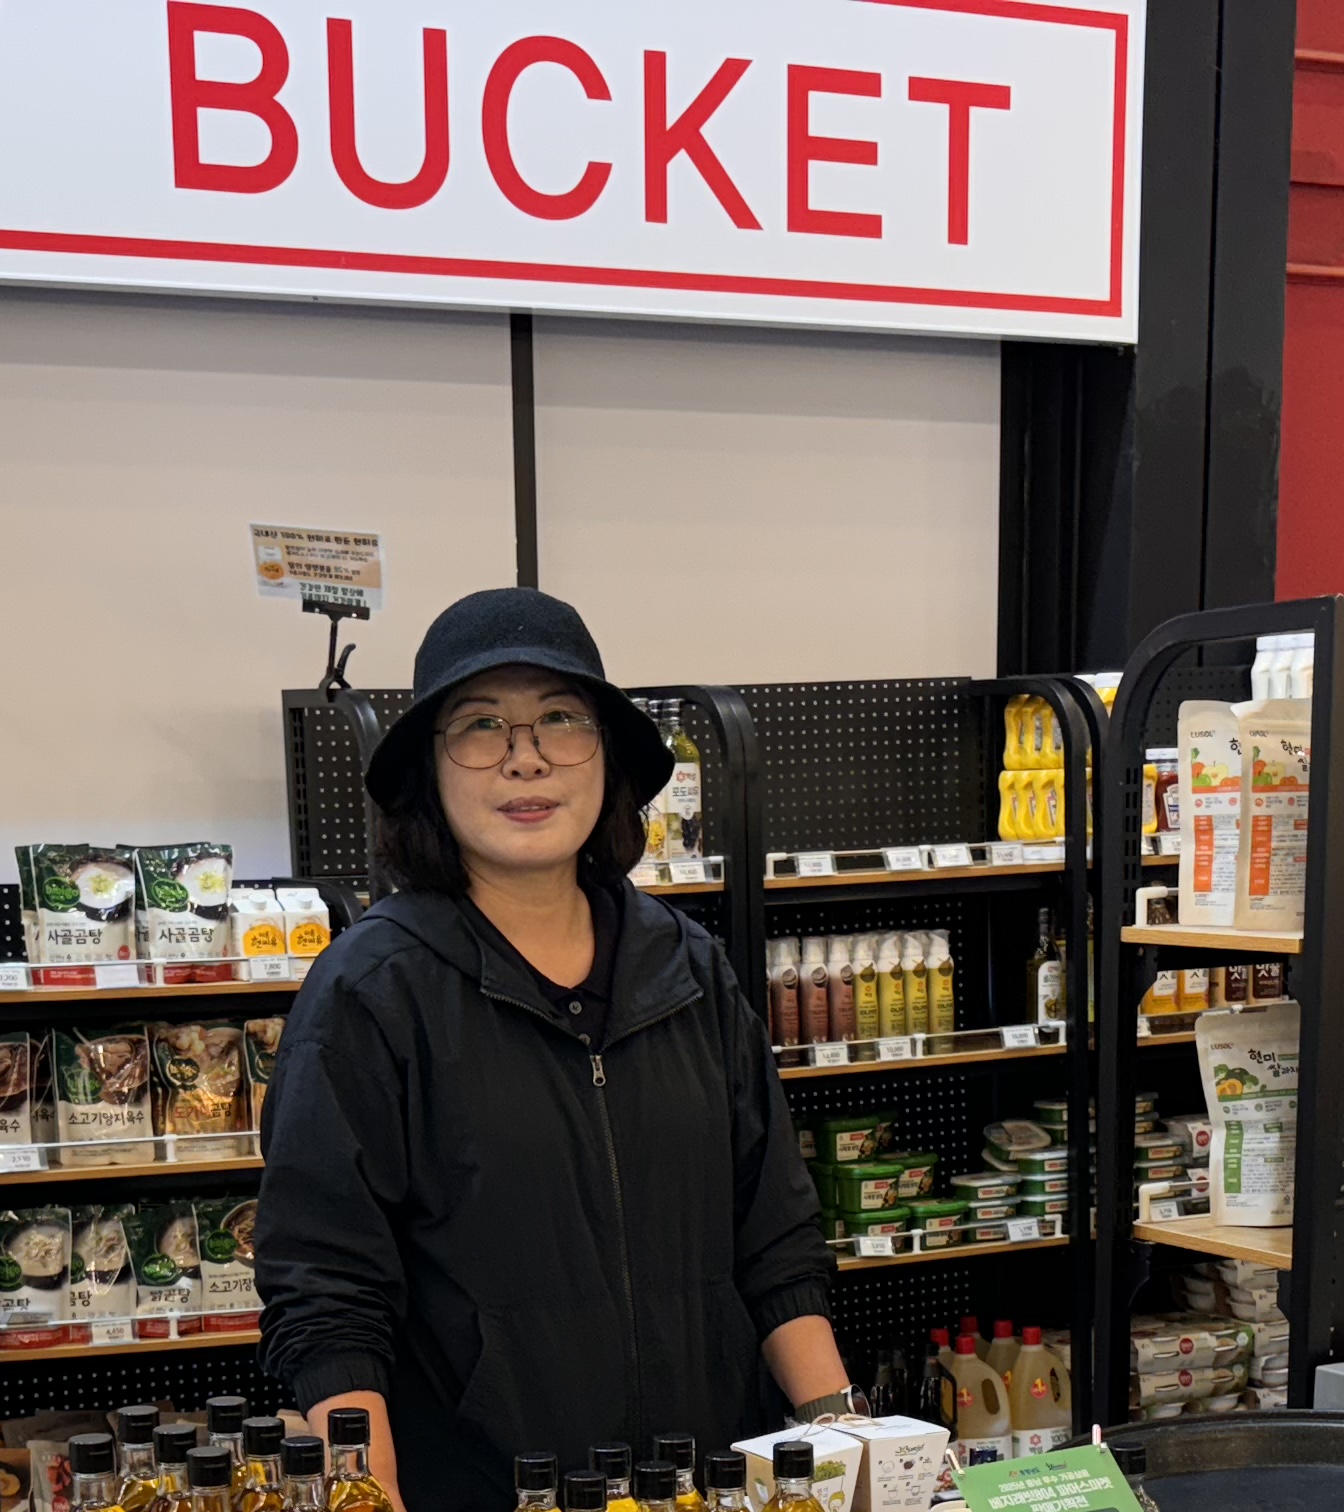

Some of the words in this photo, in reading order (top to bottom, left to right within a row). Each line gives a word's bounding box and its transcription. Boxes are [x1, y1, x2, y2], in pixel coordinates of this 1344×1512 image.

[168, 0, 1011, 245] BUCKET
[47, 928, 103, 945] 사골곰탕
[159, 927, 214, 943] 사골곰탕
[1248, 1049, 1276, 1064] 현미
[69, 1111, 144, 1126] 소고기양지육수
